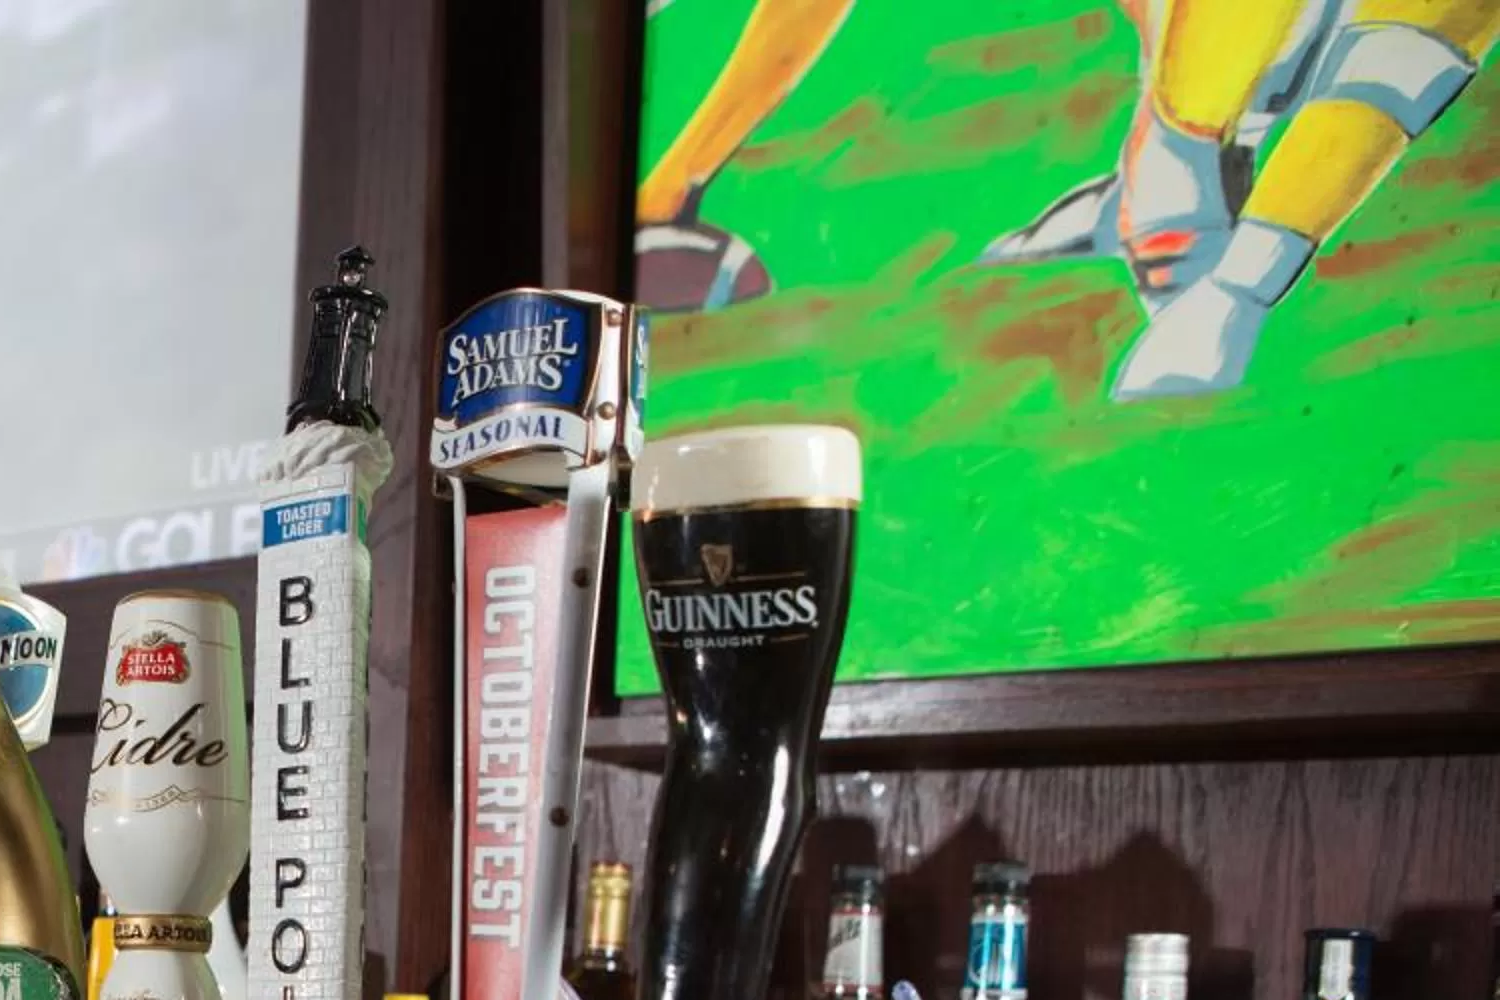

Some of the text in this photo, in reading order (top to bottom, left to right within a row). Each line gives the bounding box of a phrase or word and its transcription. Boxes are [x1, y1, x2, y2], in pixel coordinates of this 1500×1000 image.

[447, 318, 578, 375] SAMUEL
[451, 354, 563, 406] ADAMS
[439, 414, 565, 463] SEASONAL
[276, 501, 331, 524] TOASTED
[281, 520, 325, 541] LAGER
[115, 503, 260, 571] GOLF
[645, 586, 818, 632] GUINNESS
[0, 637, 58, 664] MOON
[128, 652, 176, 665] STELLA
[683, 635, 765, 649] DRAUGHT
[127, 664, 176, 677] ARTOIS
[275, 576, 315, 822] BLUE
[91, 698, 229, 774] Cidre
[469, 565, 536, 950] OCTOBERFEST
